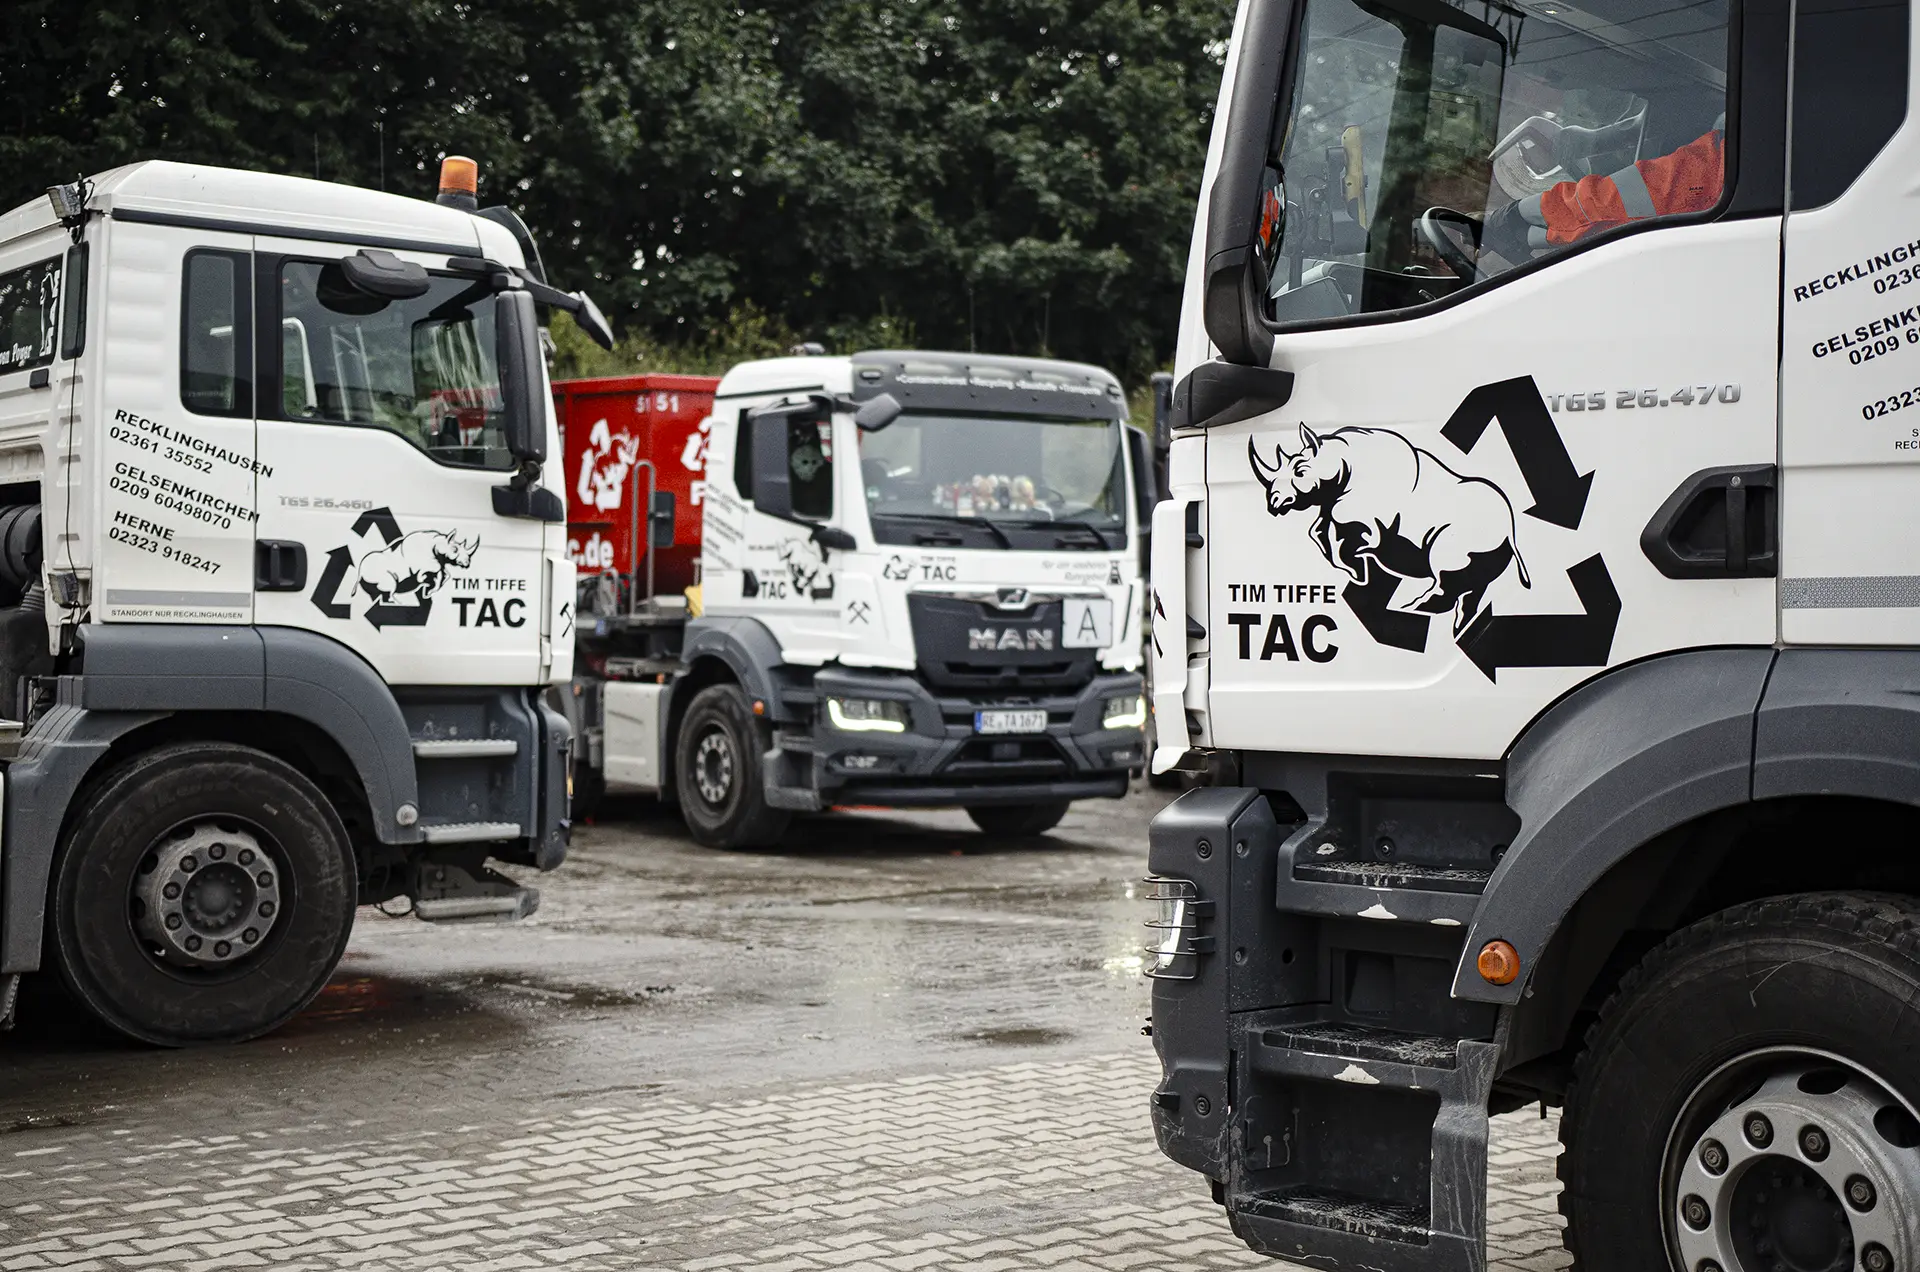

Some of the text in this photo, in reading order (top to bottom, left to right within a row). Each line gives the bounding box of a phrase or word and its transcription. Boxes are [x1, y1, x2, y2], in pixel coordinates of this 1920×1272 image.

[1848, 335, 1900, 365] 0209
[656, 392, 679, 413] 51
[1547, 383, 1741, 412] TGS 26.470
[110, 427, 213, 474] 02361 35552
[115, 409, 274, 478] RECKLINGHAUSEN
[110, 477, 231, 530] 0209 60498070
[115, 462, 260, 524] GELSENKIRCHEN
[278, 496, 373, 509] TGS 26.460
[114, 511, 176, 541] HERNE
[109, 527, 221, 575] 02323 918247
[452, 578, 526, 591] TIM TIFFE
[920, 565, 957, 581] TAC
[760, 581, 787, 599] TAC
[1228, 584, 1336, 603] TIM TIFFE
[111, 609, 243, 619] STANDORT NUR RECKLINGHAUSEN
[451, 597, 526, 628] TAC
[1077, 604, 1098, 640] A
[968, 628, 1054, 650] MAN
[1228, 613, 1339, 663] TAC
[1004, 714, 1016, 728] TA
